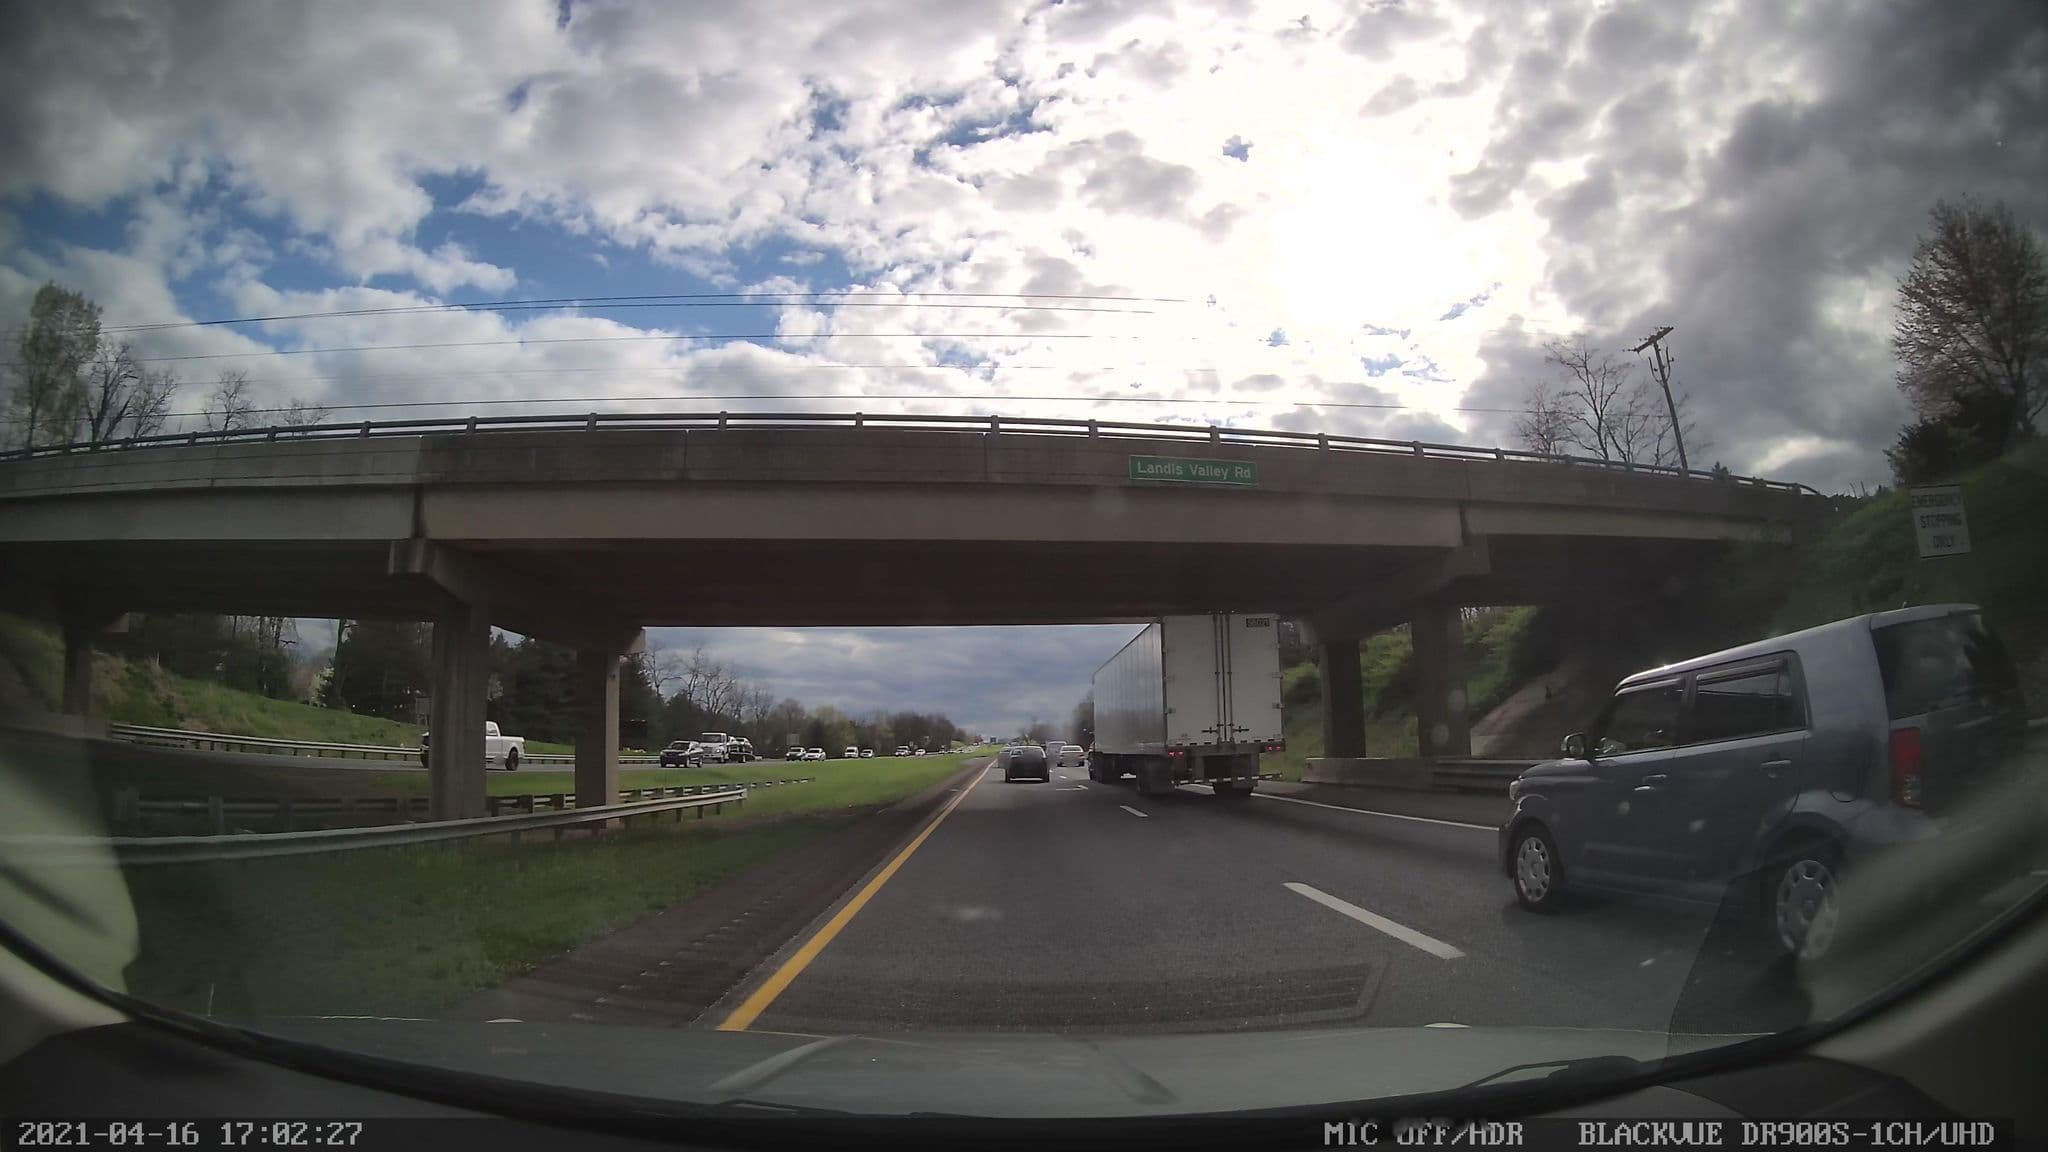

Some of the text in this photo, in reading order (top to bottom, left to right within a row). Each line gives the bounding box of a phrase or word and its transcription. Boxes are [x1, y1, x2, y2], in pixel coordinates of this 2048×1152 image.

[1137, 460, 1251, 479] Landis Valley Rd
